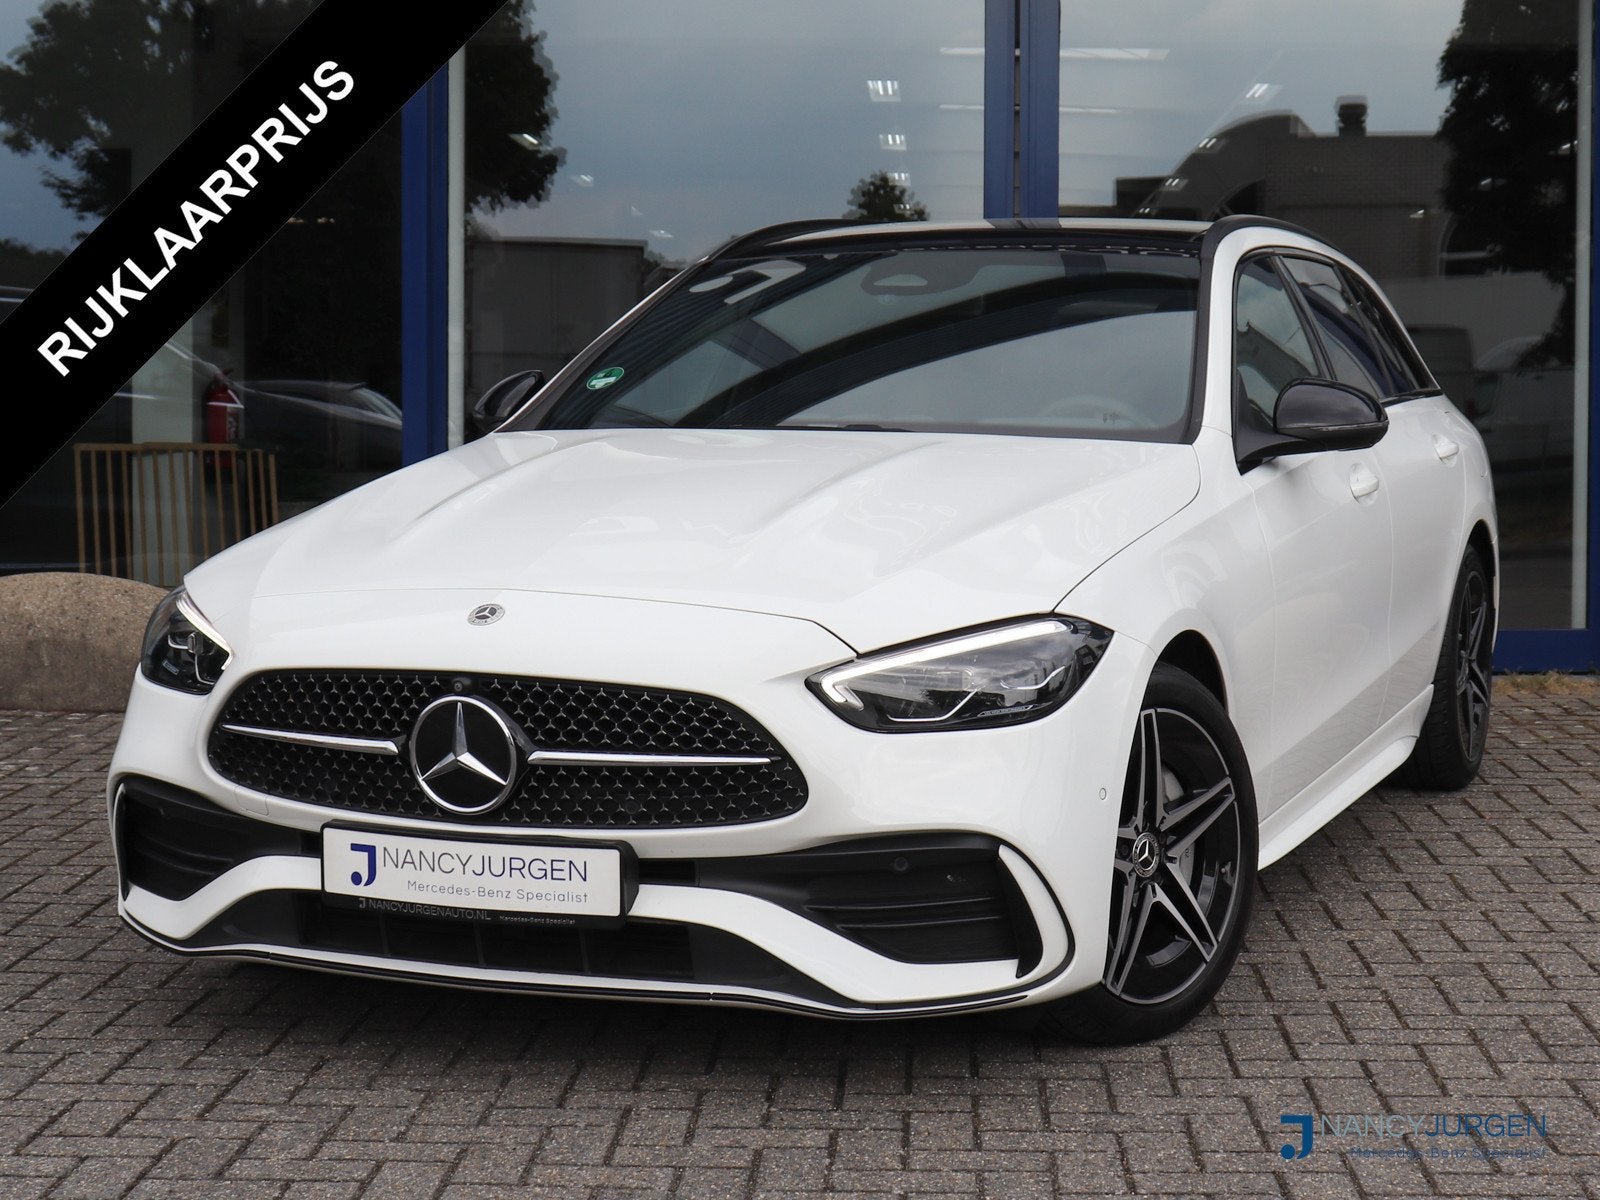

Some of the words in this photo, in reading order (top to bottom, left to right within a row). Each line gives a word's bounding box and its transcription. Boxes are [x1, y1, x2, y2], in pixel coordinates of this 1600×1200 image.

[383, 846, 588, 882] NANCYJURGEN
[407, 880, 511, 899] Mercedes-Benz
[517, 888, 588, 903] Specialist
[369, 899, 491, 920] NANCYJURGENAUTO.NL
